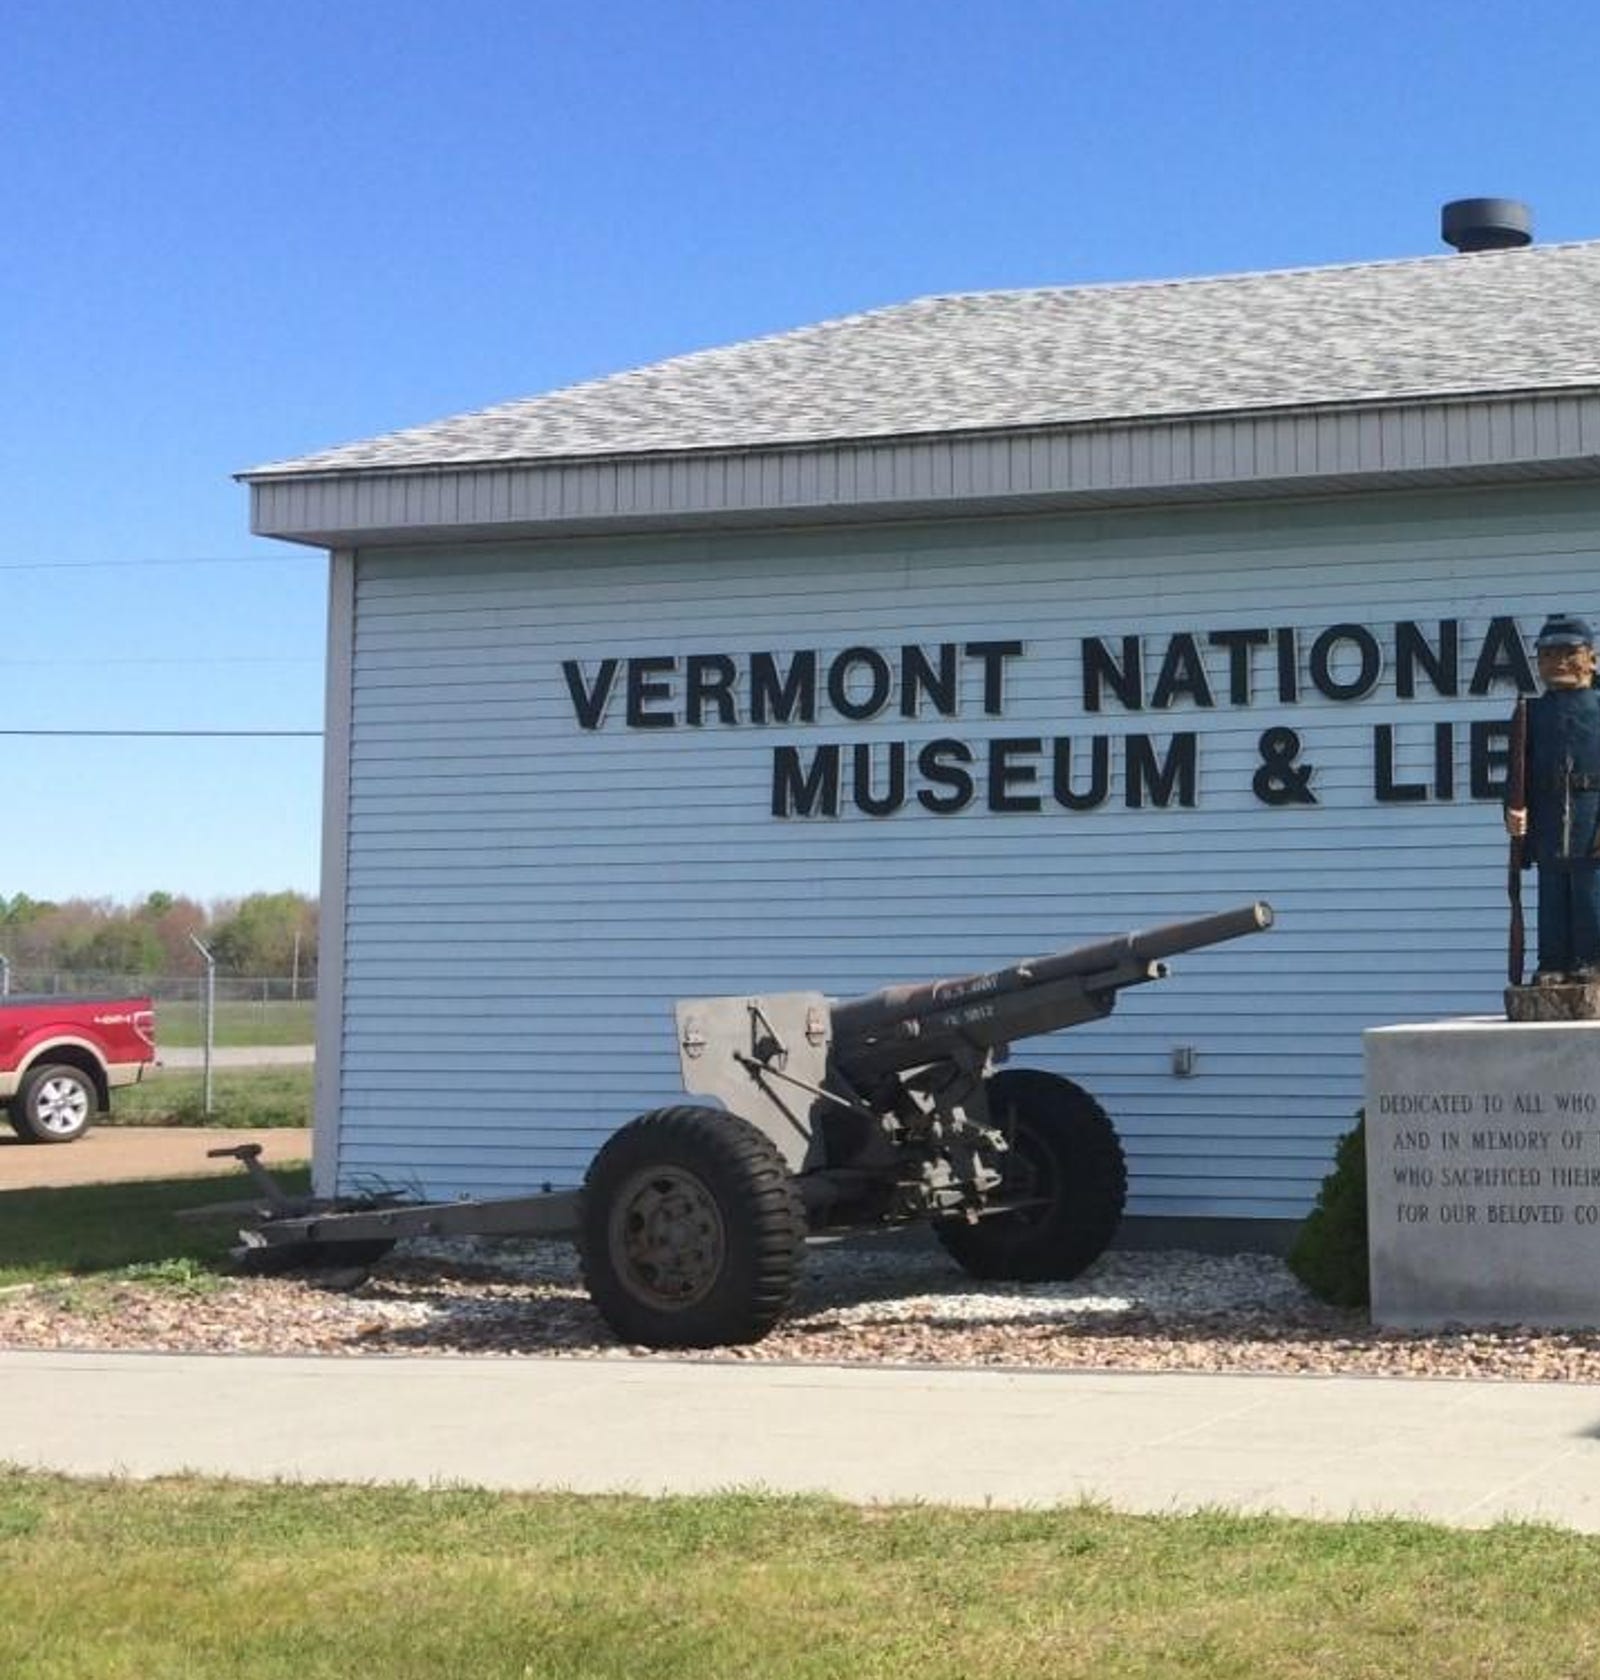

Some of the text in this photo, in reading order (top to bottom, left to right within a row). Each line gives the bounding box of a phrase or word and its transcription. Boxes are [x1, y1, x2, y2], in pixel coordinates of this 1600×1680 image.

[562, 641, 1025, 730] VERMONT
[771, 731, 1201, 818] MUSEUM
[1252, 726, 1318, 806] &
[1379, 1093, 1474, 1115] DEDICATED
[1484, 1094, 1501, 1113] TO
[1513, 1093, 1545, 1113] ALL
[1556, 1093, 1597, 1113] WHO
[1393, 1131, 1431, 1151] AND
[1441, 1131, 1461, 1150] IN
[1471, 1131, 1550, 1150] MEMORY
[1561, 1131, 1584, 1150] OF
[1393, 1167, 1433, 1187] WHO
[1440, 1167, 1541, 1187] SACRIFICED
[1396, 1204, 1430, 1224] FOR
[1440, 1204, 1476, 1224] OUR
[1487, 1204, 1564, 1224] BELOVED
